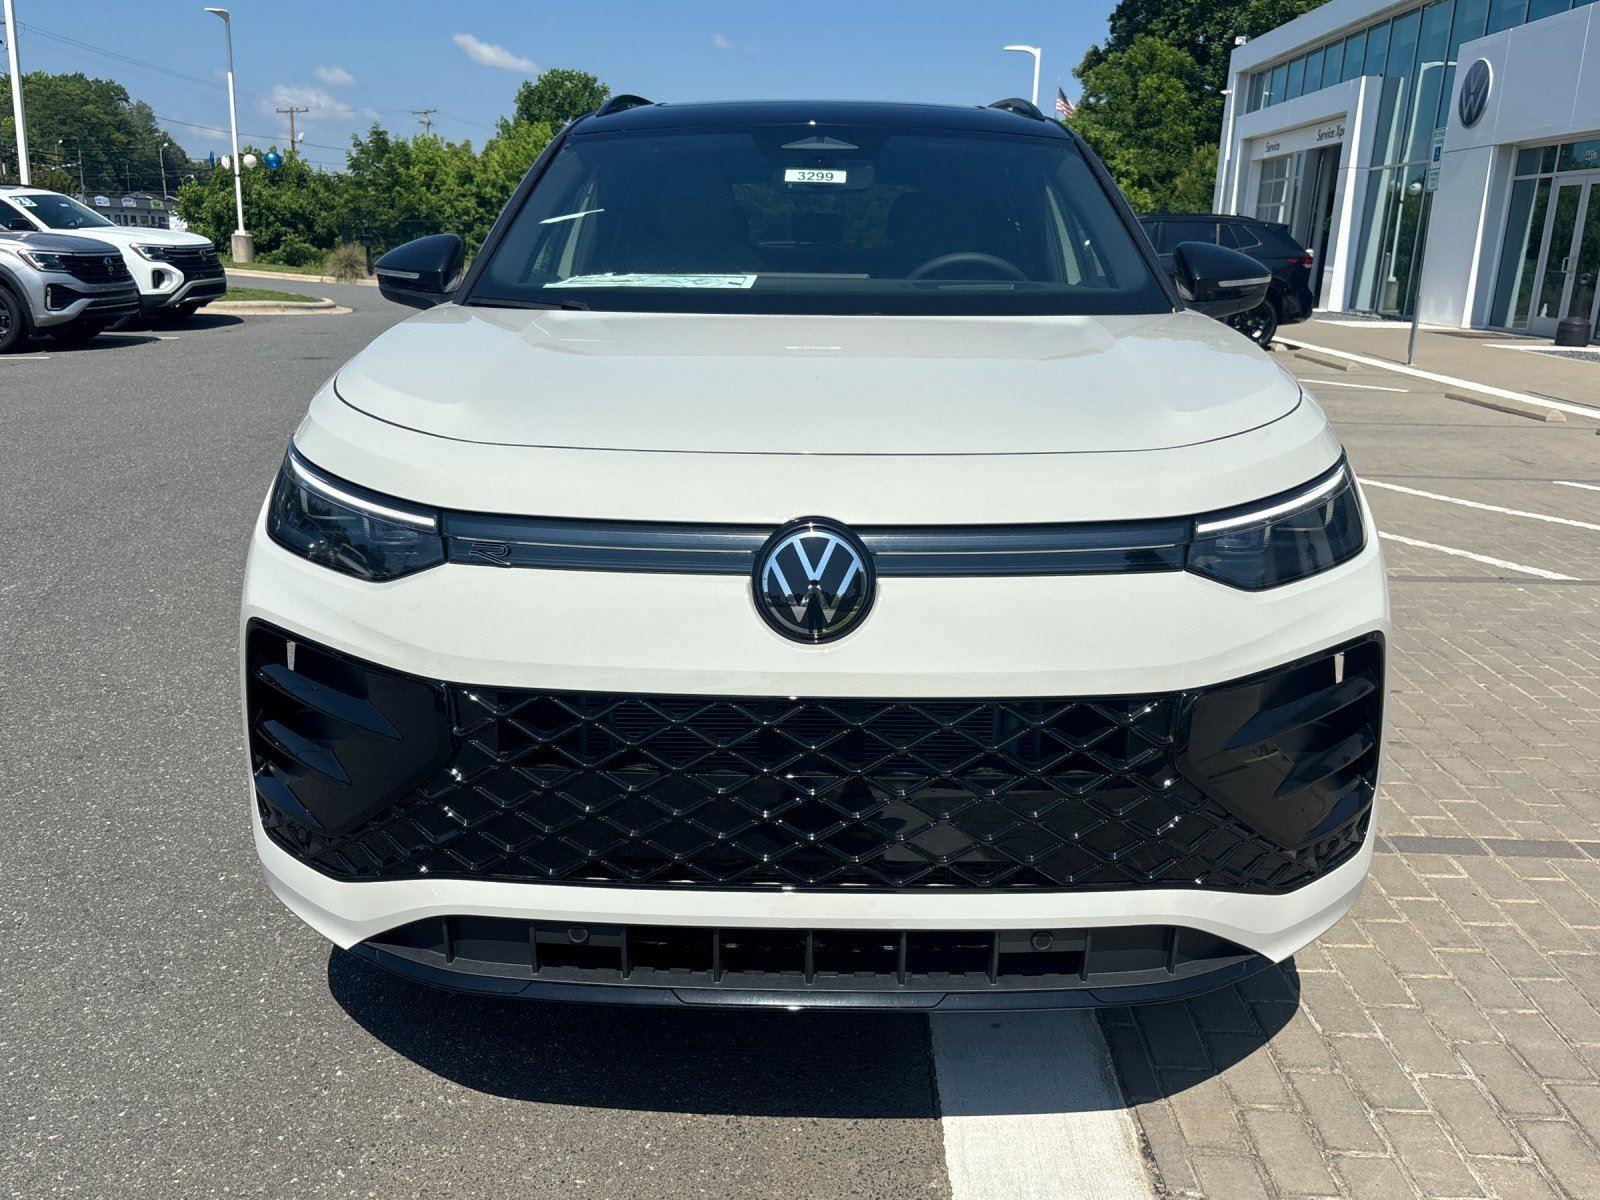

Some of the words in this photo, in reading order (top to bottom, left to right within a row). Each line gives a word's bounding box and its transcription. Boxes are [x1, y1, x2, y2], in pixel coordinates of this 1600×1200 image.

[1460, 61, 1489, 123] VW
[1317, 127, 1335, 142] Service
[1265, 140, 1280, 153] Service
[797, 171, 834, 182] 3299
[763, 532, 866, 632] VW
